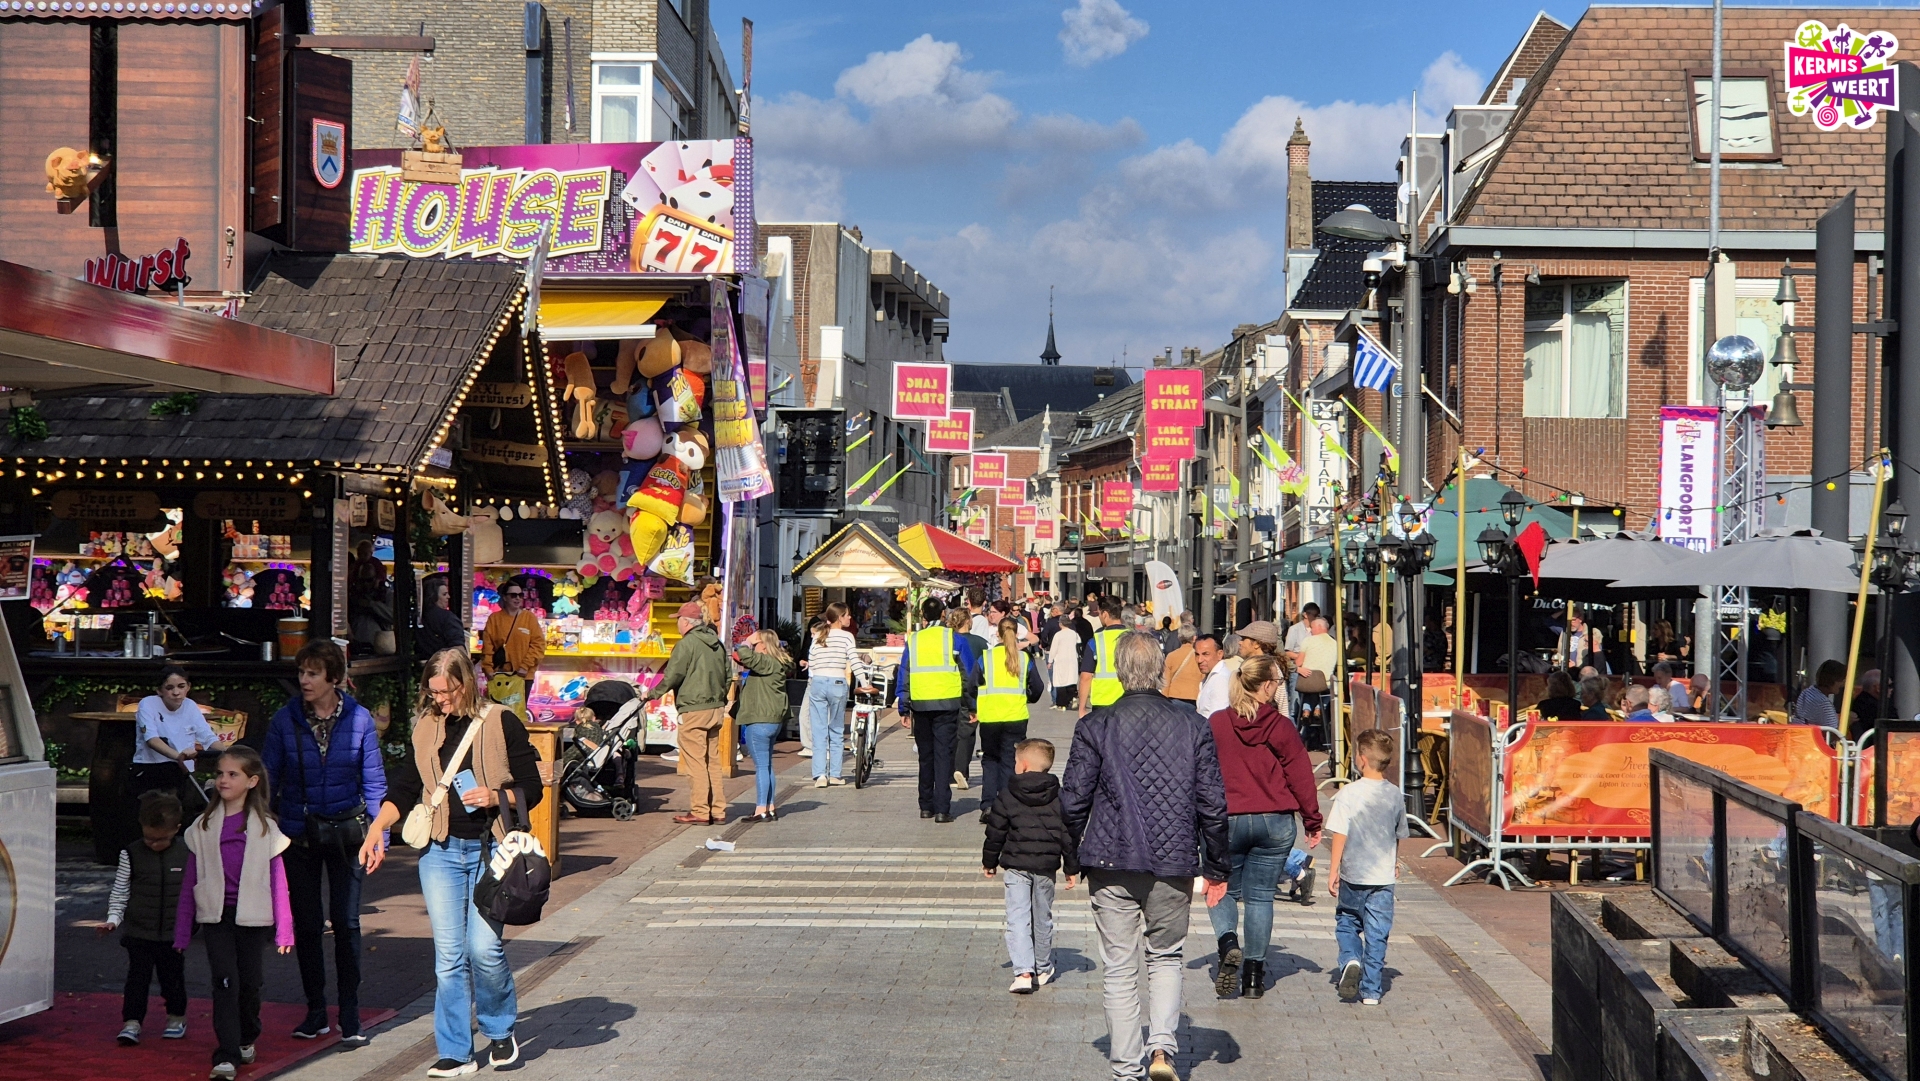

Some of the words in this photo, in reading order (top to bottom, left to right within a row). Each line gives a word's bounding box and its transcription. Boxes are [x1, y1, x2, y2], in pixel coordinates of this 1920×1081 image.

[350, 167, 612, 257] HOUSE
[655, 228, 682, 264] 7
[84, 236, 189, 293] Wurst
[1159, 384, 1189, 395] LANG
[1151, 399, 1198, 410] STRAAT
[1158, 426, 1183, 435] LANG
[1152, 437, 1190, 446] STRAAT
[1145, 473, 1175, 481] STRAAT
[1678, 445, 1694, 535] LANGPOORT
